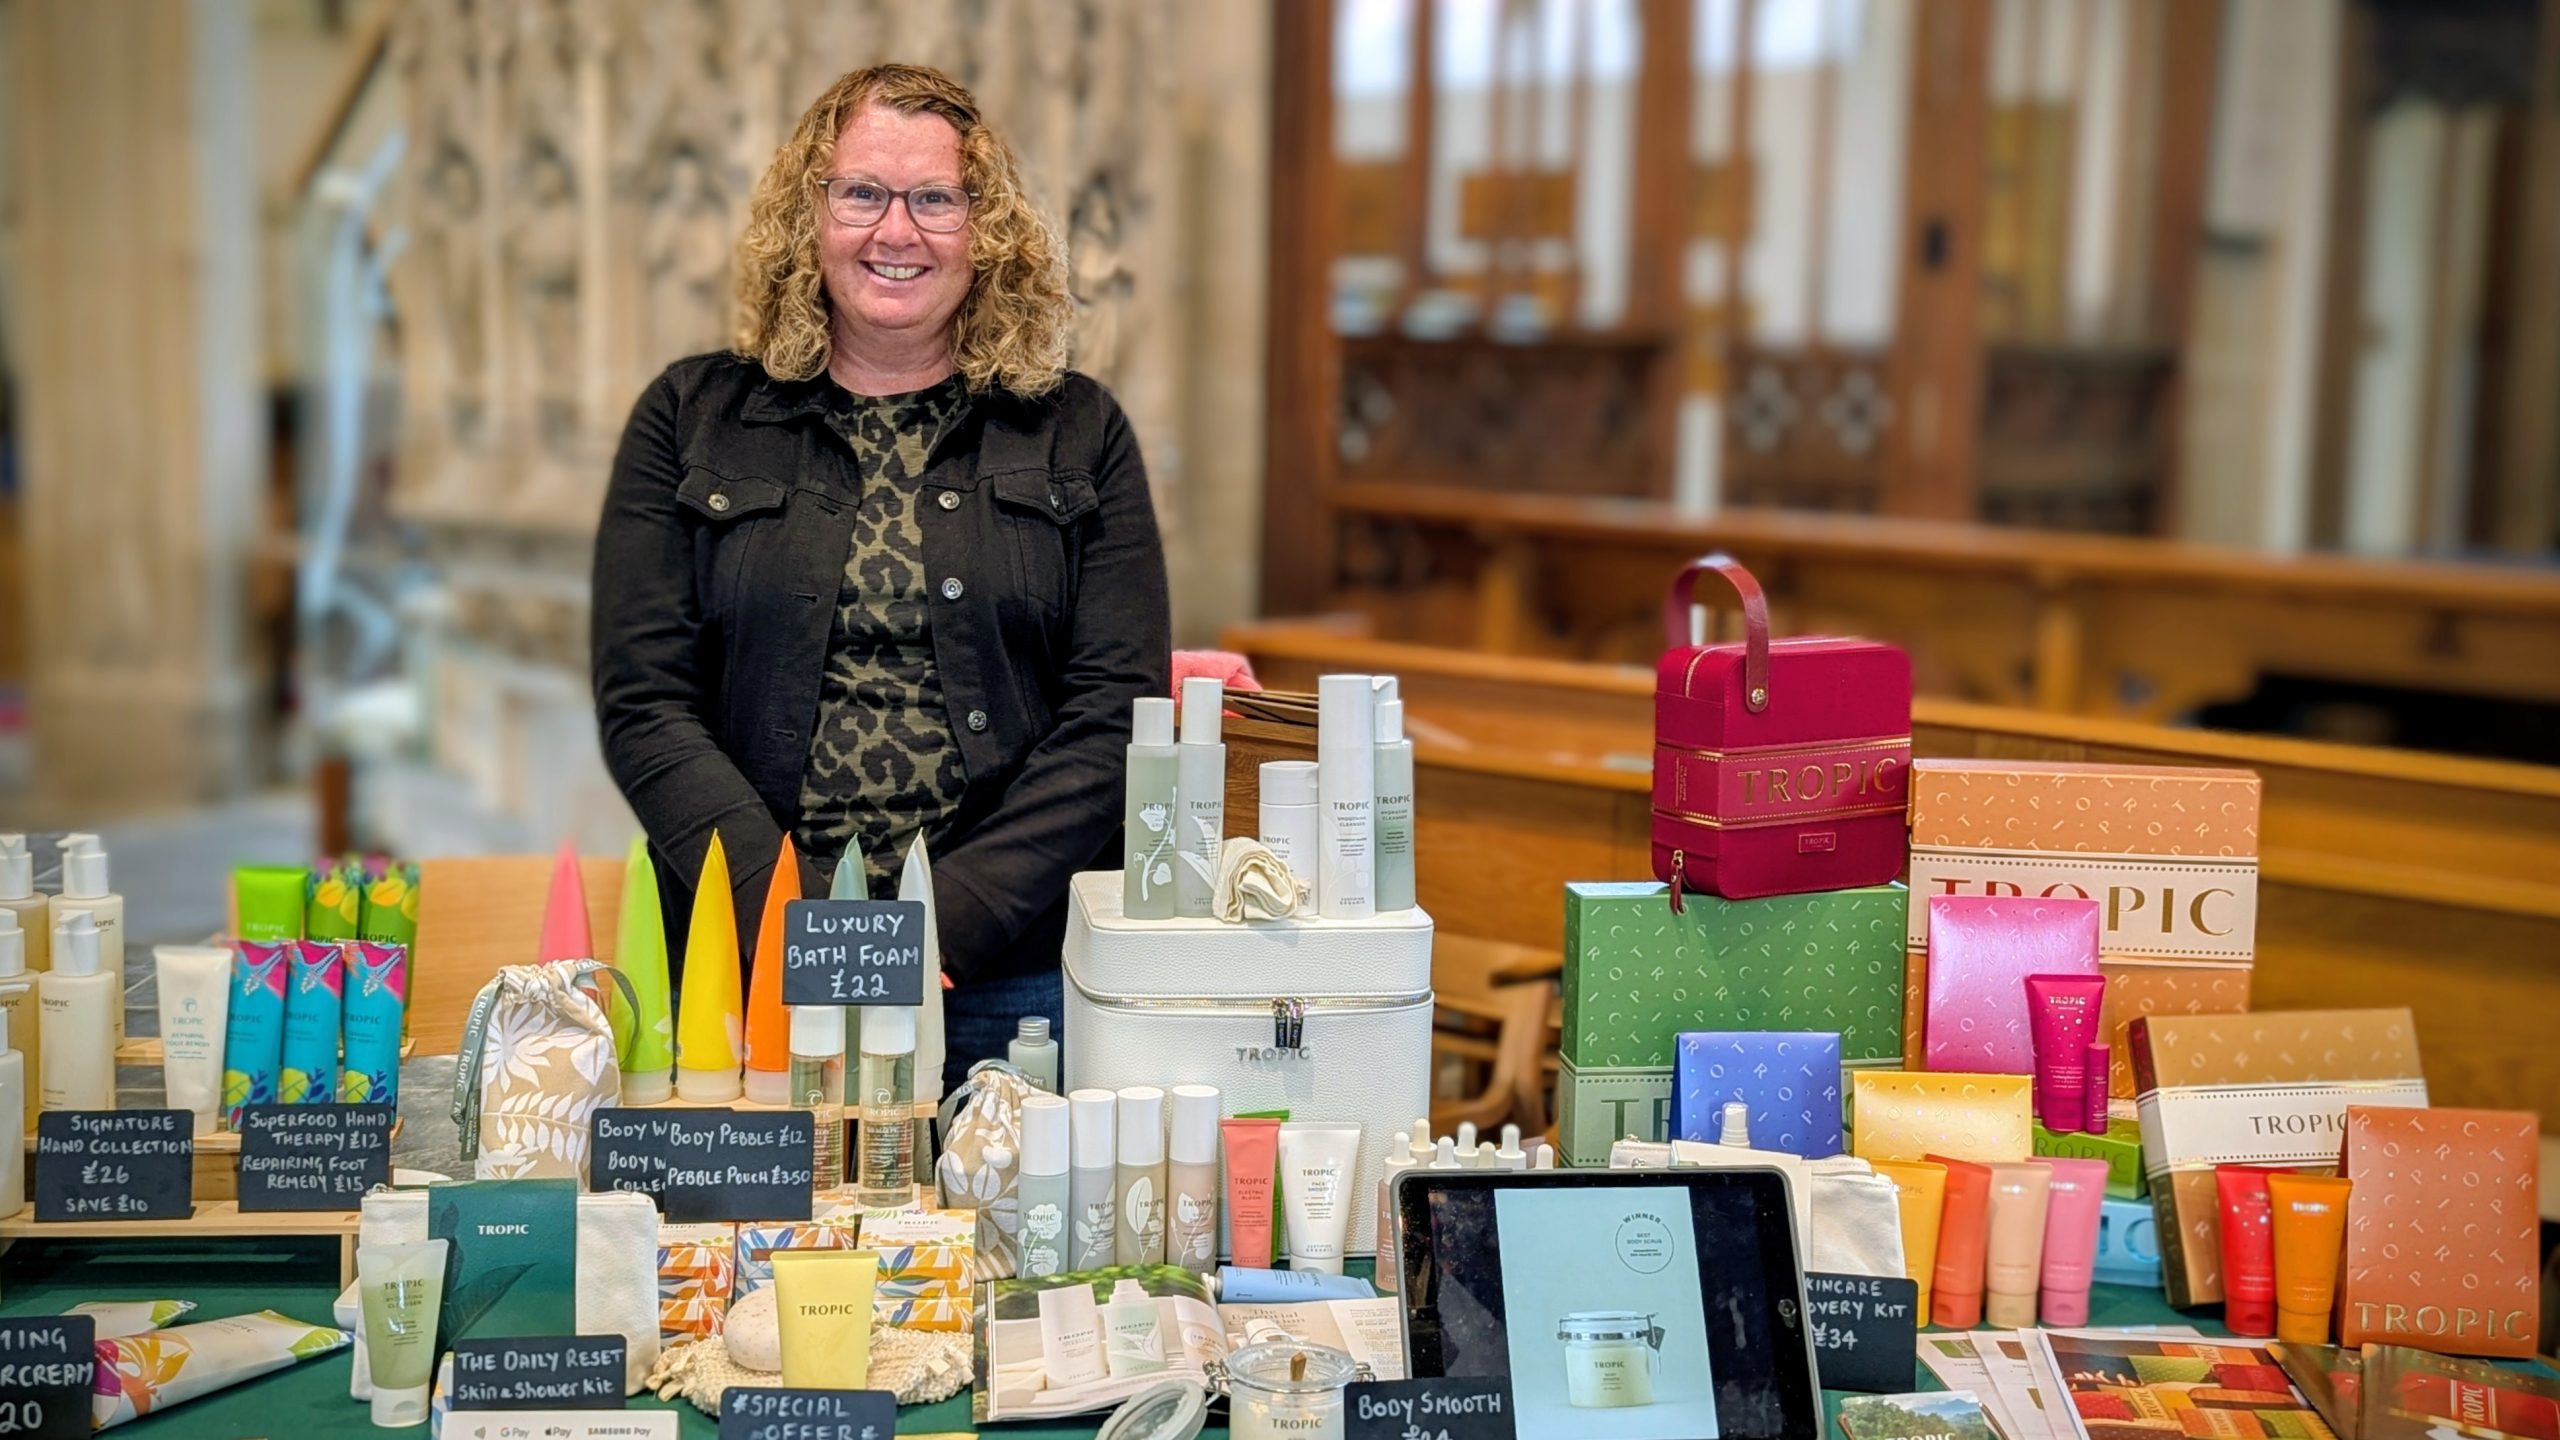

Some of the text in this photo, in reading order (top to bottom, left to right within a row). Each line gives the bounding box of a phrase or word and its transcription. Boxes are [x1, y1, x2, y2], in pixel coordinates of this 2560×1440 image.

[1738, 758, 1897, 806] TROPIC
[1333, 801, 1369, 811] TROPIC
[1376, 795, 1411, 804] TROPIC
[806, 911, 904, 936] LUXURY
[787, 944, 918, 969] BATH FOAM
[830, 968, 890, 998] £22
[473, 996, 488, 1038] TROPIC
[1236, 1046, 1310, 1061] TROPIC
[455, 1049, 472, 1092] TROPIC
[71, 1115, 175, 1133] SIGNATURE
[249, 1111, 387, 1129] SUPERFOOD HAND
[599, 1118, 667, 1140] BODY W
[40, 1138, 192, 1155] HAND COLLECTION
[271, 1131, 382, 1151] THERAPY £12
[670, 1123, 806, 1153] BODY PEBBLE £12
[242, 1155, 368, 1173] REPAIRING FOOT
[608, 1150, 648, 1173] BODY
[81, 1161, 130, 1185] £26
[667, 1167, 722, 1186] PEBBLE
[727, 1166, 768, 1185] POUCH
[1234, 1177, 1268, 1185] TROPIC
[1302, 1168, 1336, 1177] TROPIC
[267, 1174, 364, 1193] REMEDY £15
[613, 1177, 666, 1192] COLLE
[66, 1195, 149, 1213] SAVE £10
[1623, 1212, 1662, 1225] WINNER
[478, 1224, 530, 1235] TROPIC
[1804, 1277, 1882, 1297] KINCARE
[800, 1304, 853, 1316] TROPIC
[1808, 1300, 1907, 1320] OVERY KIT
[2354, 1301, 2532, 1341] TROPIC
[1811, 1321, 1859, 1350] £34
[458, 1348, 625, 1372] THE DAILY RESET
[0, 1362, 93, 1387] RCREAM
[750, 1394, 850, 1418] SPECIAL
[1358, 1391, 1501, 1424] BODY SMOOTH
[0, 1400, 42, 1433] 20
[1272, 1417, 1323, 1430] TROPIC
[512, 1427, 530, 1439] Pay
[552, 1427, 572, 1438] Pay
[587, 1427, 652, 1438] SAMSUNG Pay
[765, 1422, 853, 1440] OFFER
